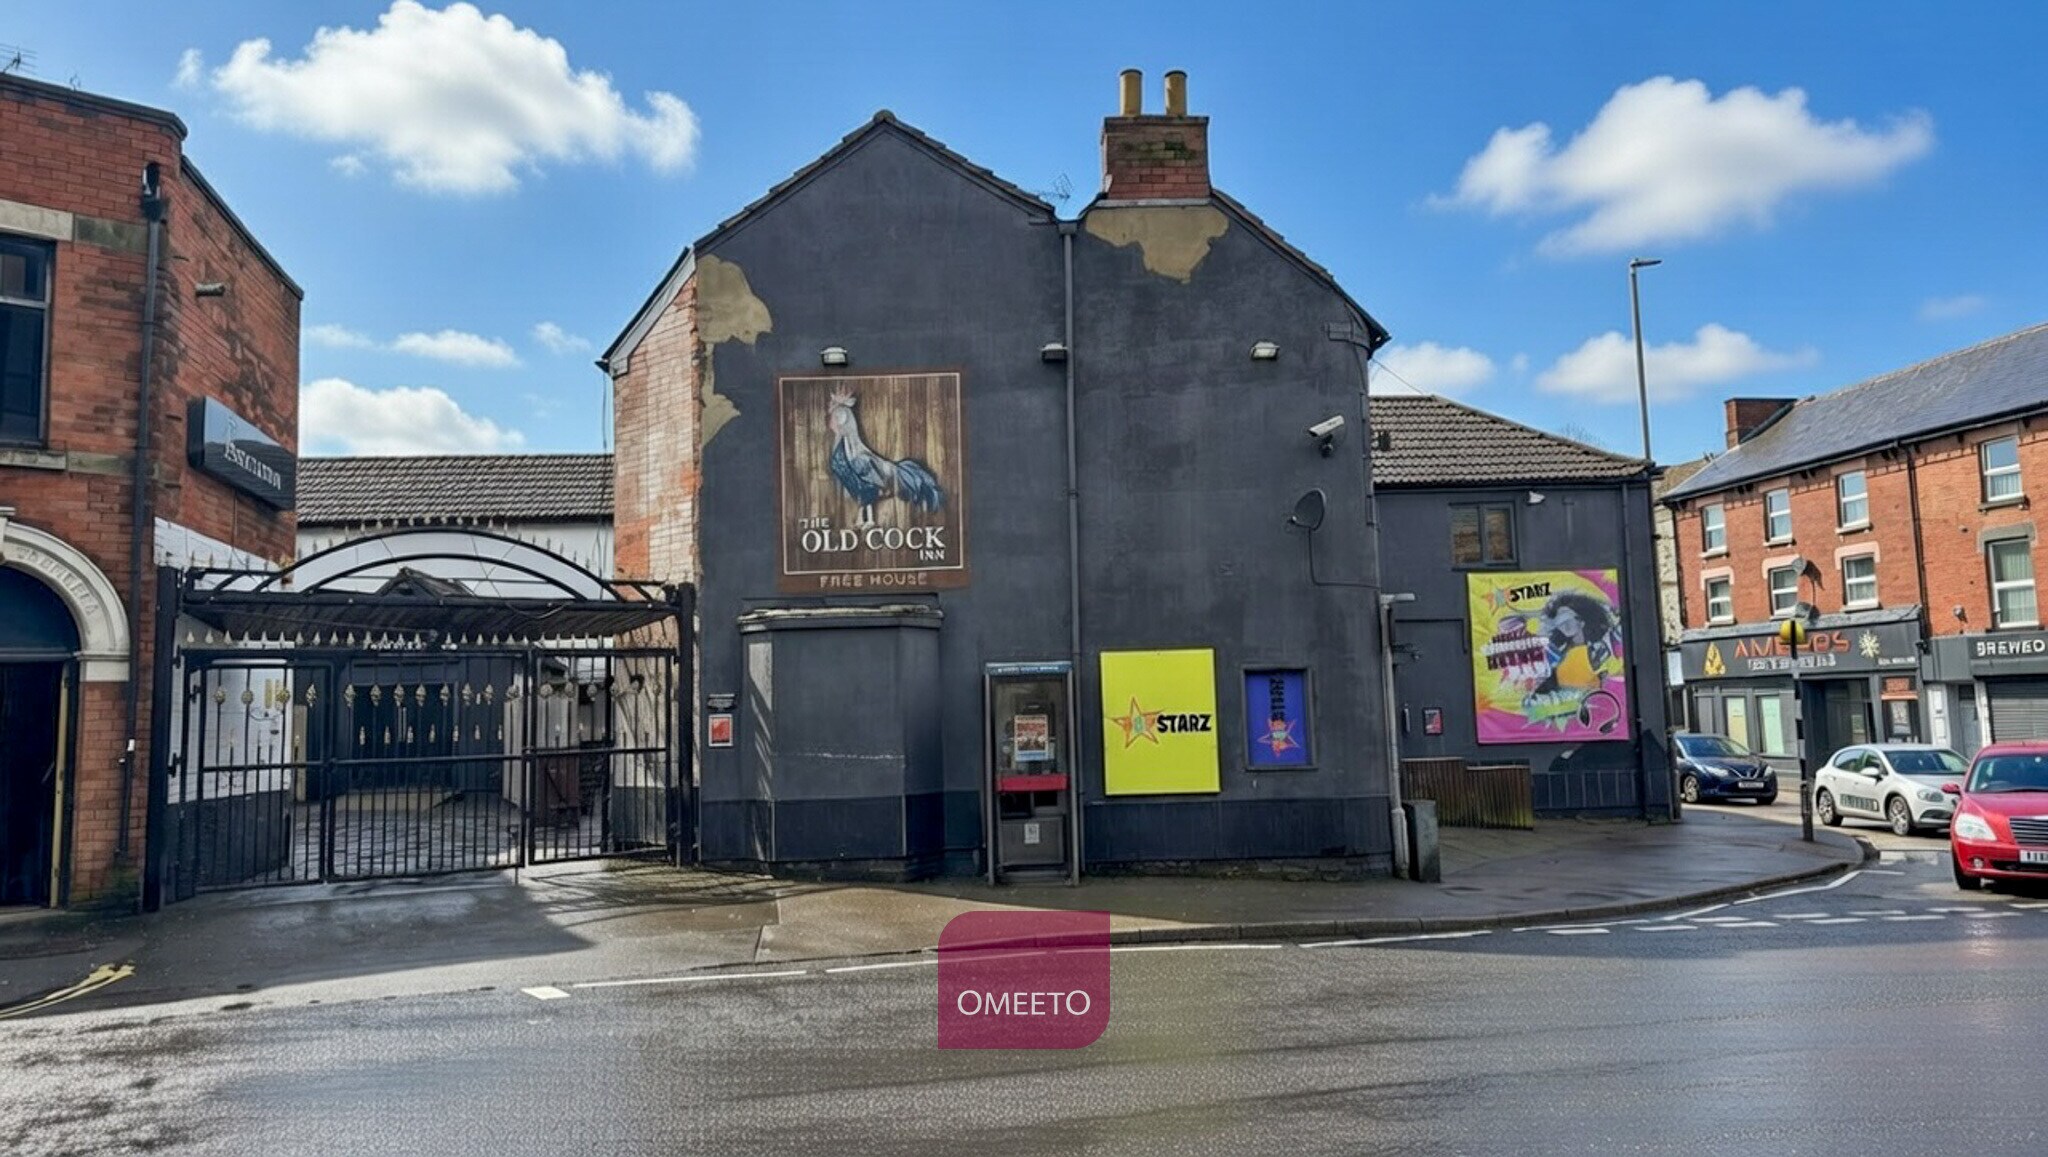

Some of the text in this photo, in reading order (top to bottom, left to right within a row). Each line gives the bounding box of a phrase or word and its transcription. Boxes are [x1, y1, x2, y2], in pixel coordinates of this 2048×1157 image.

[799, 517, 829, 529] THE
[802, 526, 946, 553] OLD COCK
[919, 549, 945, 561] INN
[869, 572, 927, 586] HOUSE
[1157, 714, 1212, 733] STARZ
